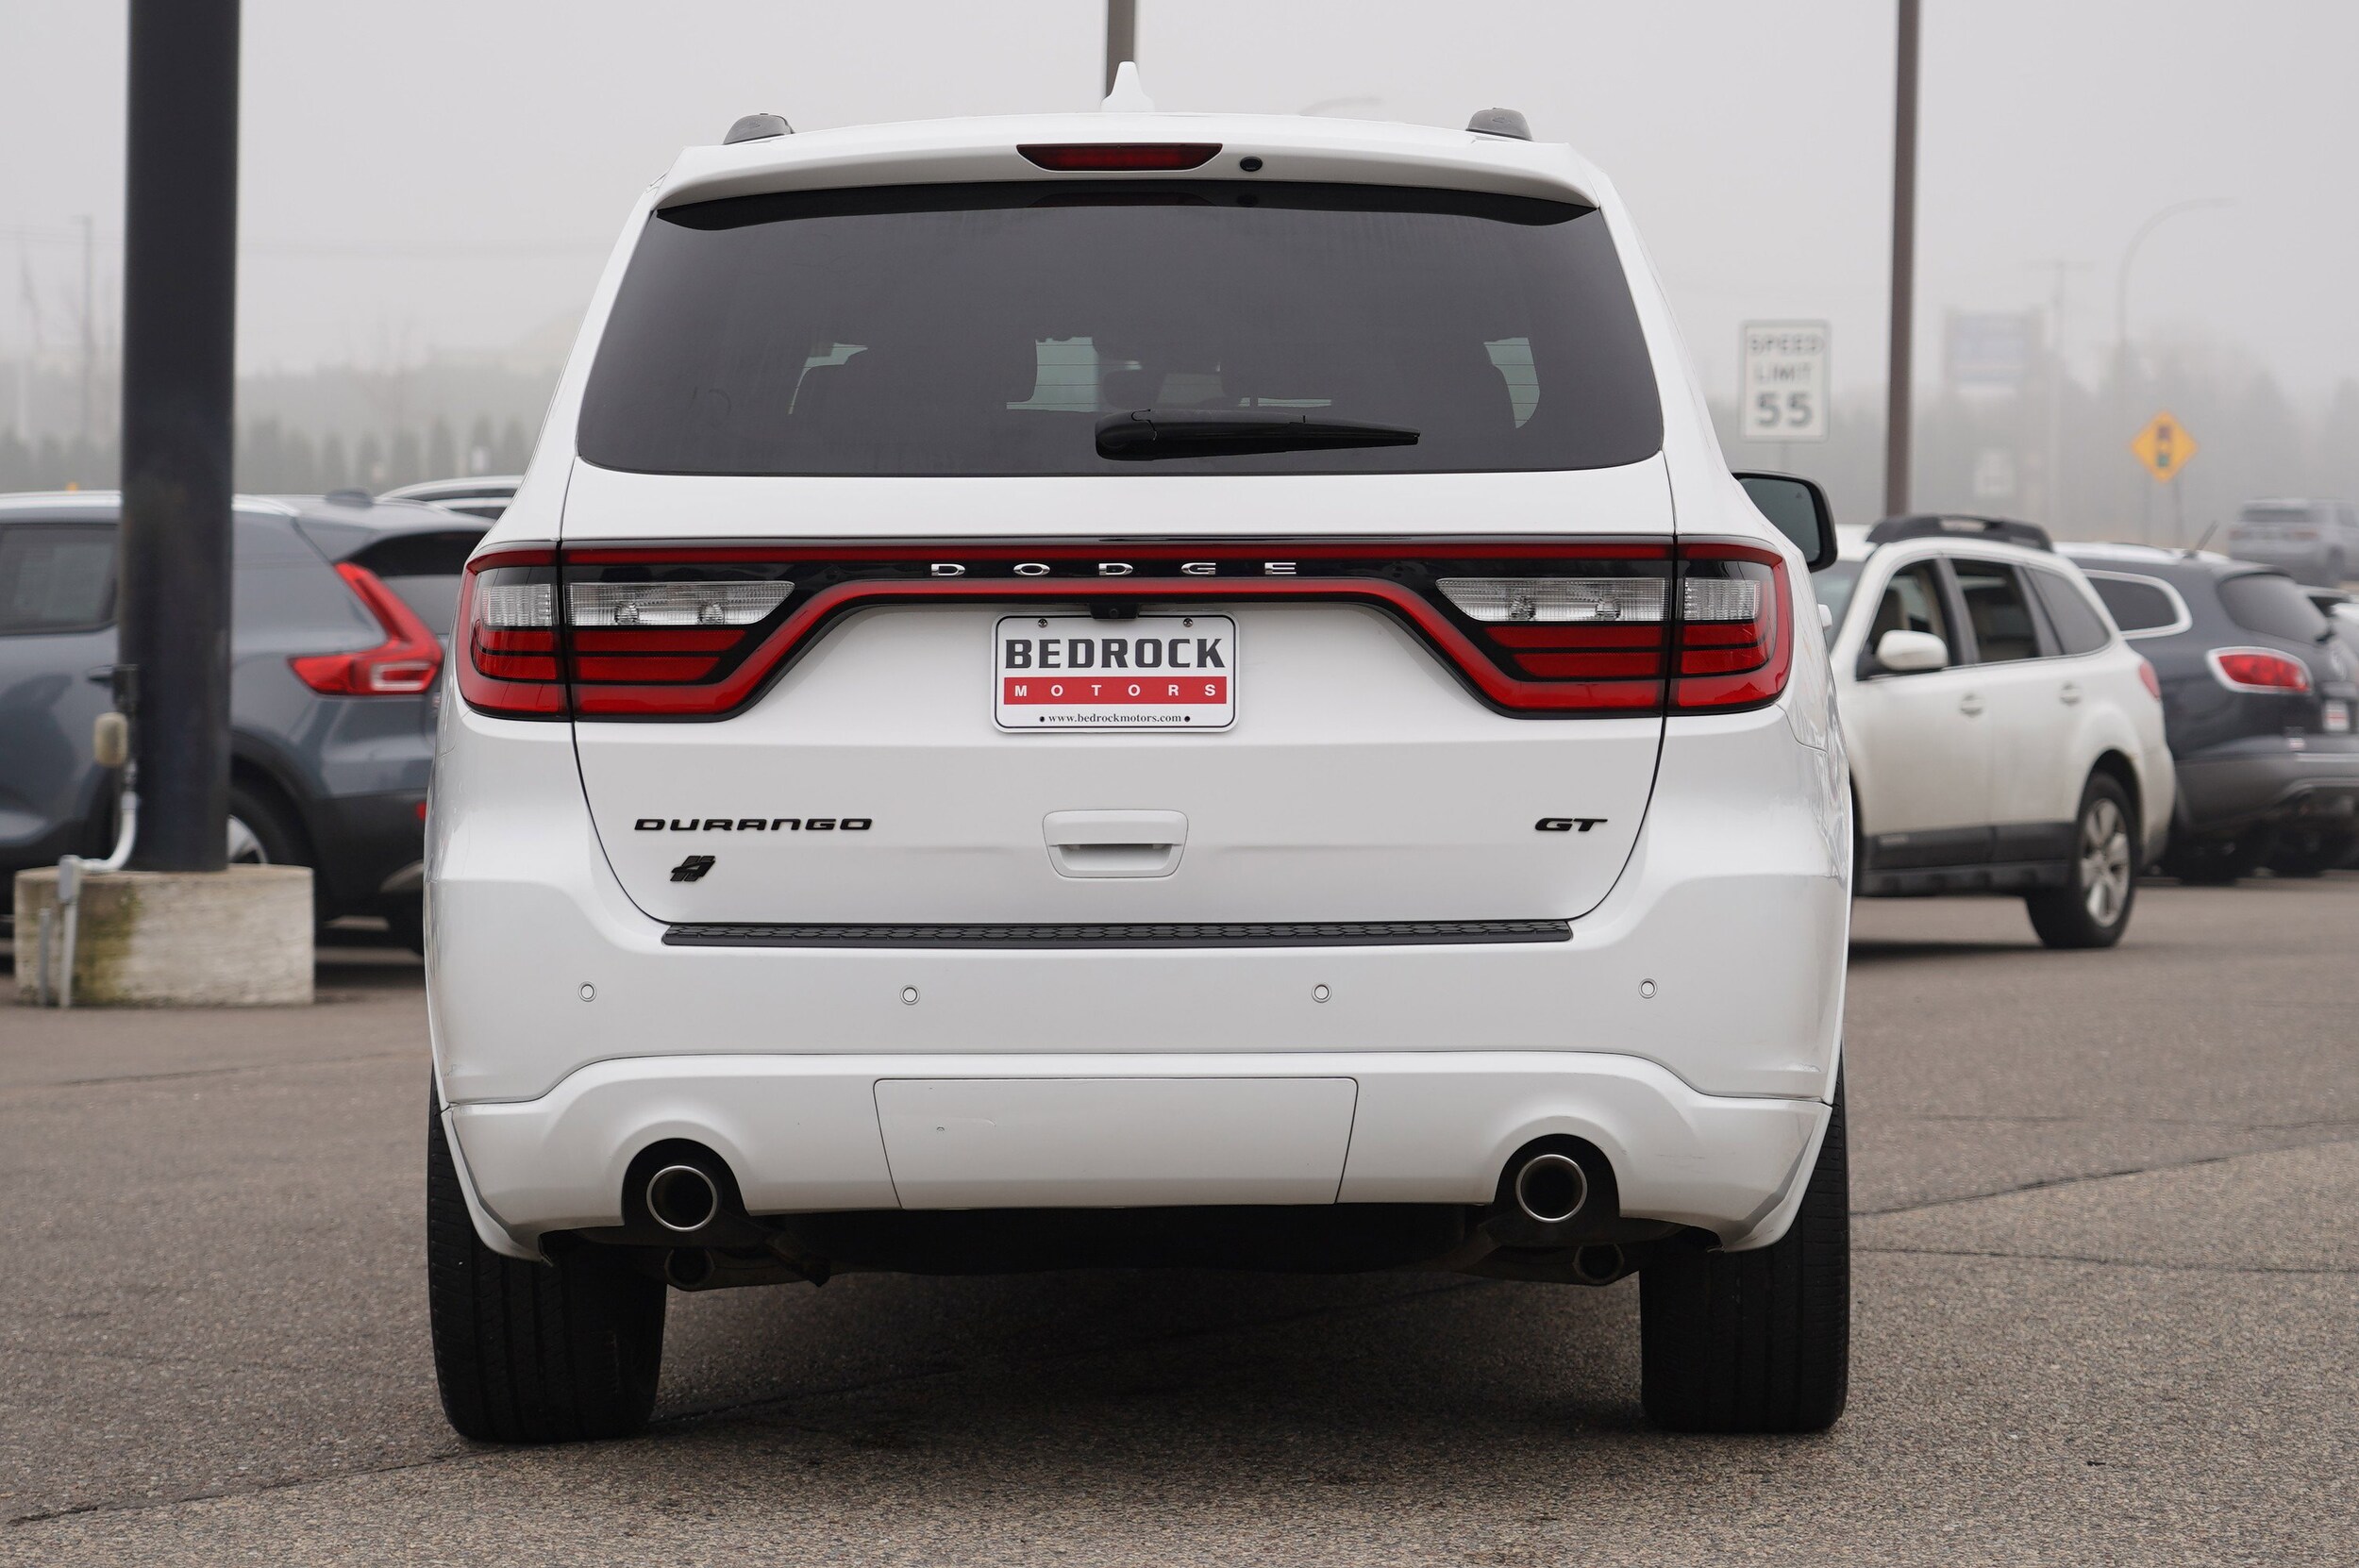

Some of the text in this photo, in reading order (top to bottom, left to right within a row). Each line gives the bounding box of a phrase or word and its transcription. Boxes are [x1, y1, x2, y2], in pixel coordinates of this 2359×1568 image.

[1756, 392, 1813, 427] 55
[930, 562, 1297, 576] DODGE
[1005, 638, 1226, 669] BEDROCK
[1014, 684, 1216, 697] MOTORS
[1048, 713, 1181, 723] www.bedrockmotors.com
[634, 818, 873, 831] DURANGO
[1534, 817, 1608, 832] GT
